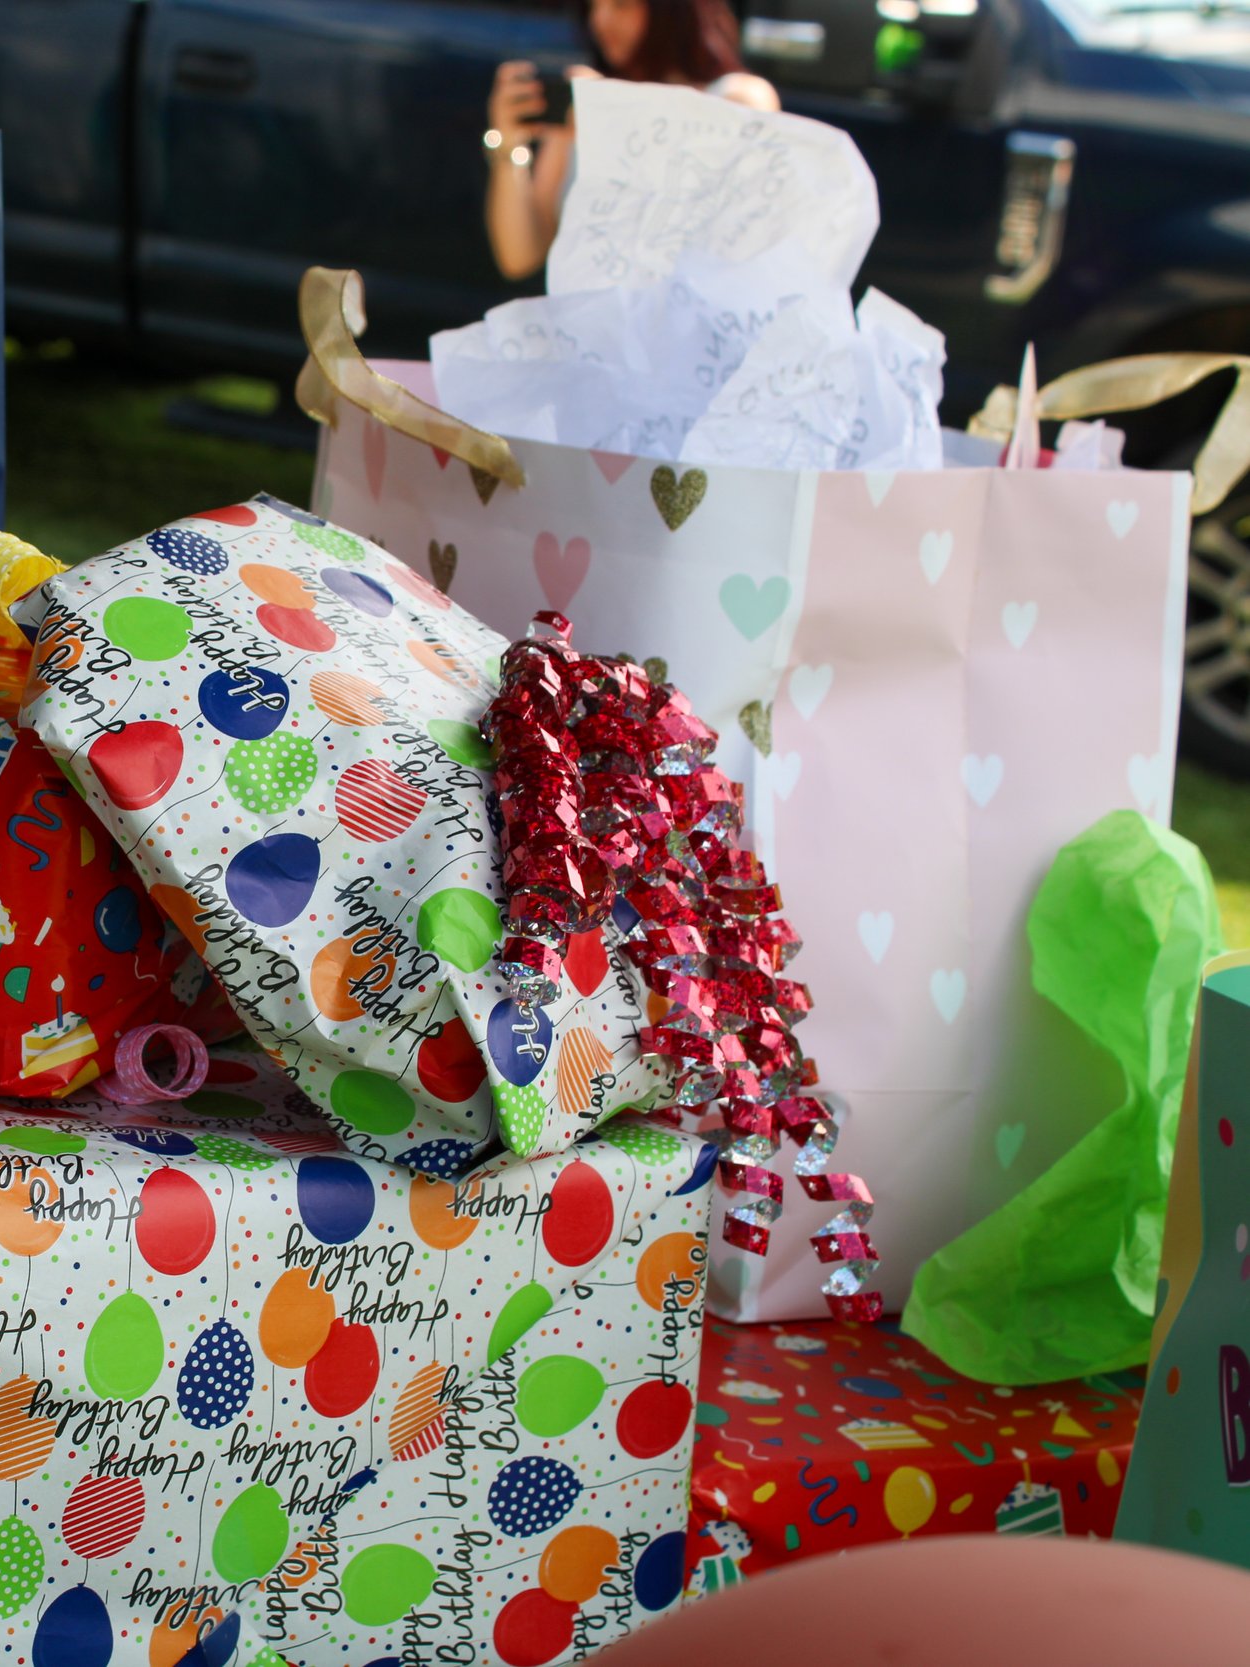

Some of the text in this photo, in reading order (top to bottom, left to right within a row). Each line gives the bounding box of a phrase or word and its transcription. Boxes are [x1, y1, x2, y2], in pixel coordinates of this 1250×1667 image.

[161, 573, 282, 670] Birthday
[36, 644, 127, 740] Happy
[187, 630, 287, 712] Happy
[365, 693, 484, 790] Birthday
[391, 759, 484, 843] Happy
[183, 863, 300, 994] Birthday
[333, 875, 440, 989] Birthday
[348, 964, 444, 1055] Happy
[55, 1122, 174, 1146] Happy
[23, 1178, 144, 1243] Happy
[445, 1182, 554, 1237] Happy
[277, 1221, 414, 1293] Birthday
[342, 1280, 449, 1343] Happy
[644, 1273, 696, 1389] Happy
[20, 1378, 170, 1446] Birthday
[427, 1394, 484, 1509] Happy
[89, 1435, 205, 1494] Happy
[220, 1422, 357, 1487] Birthday
[432, 1523, 493, 1667] Birthday
